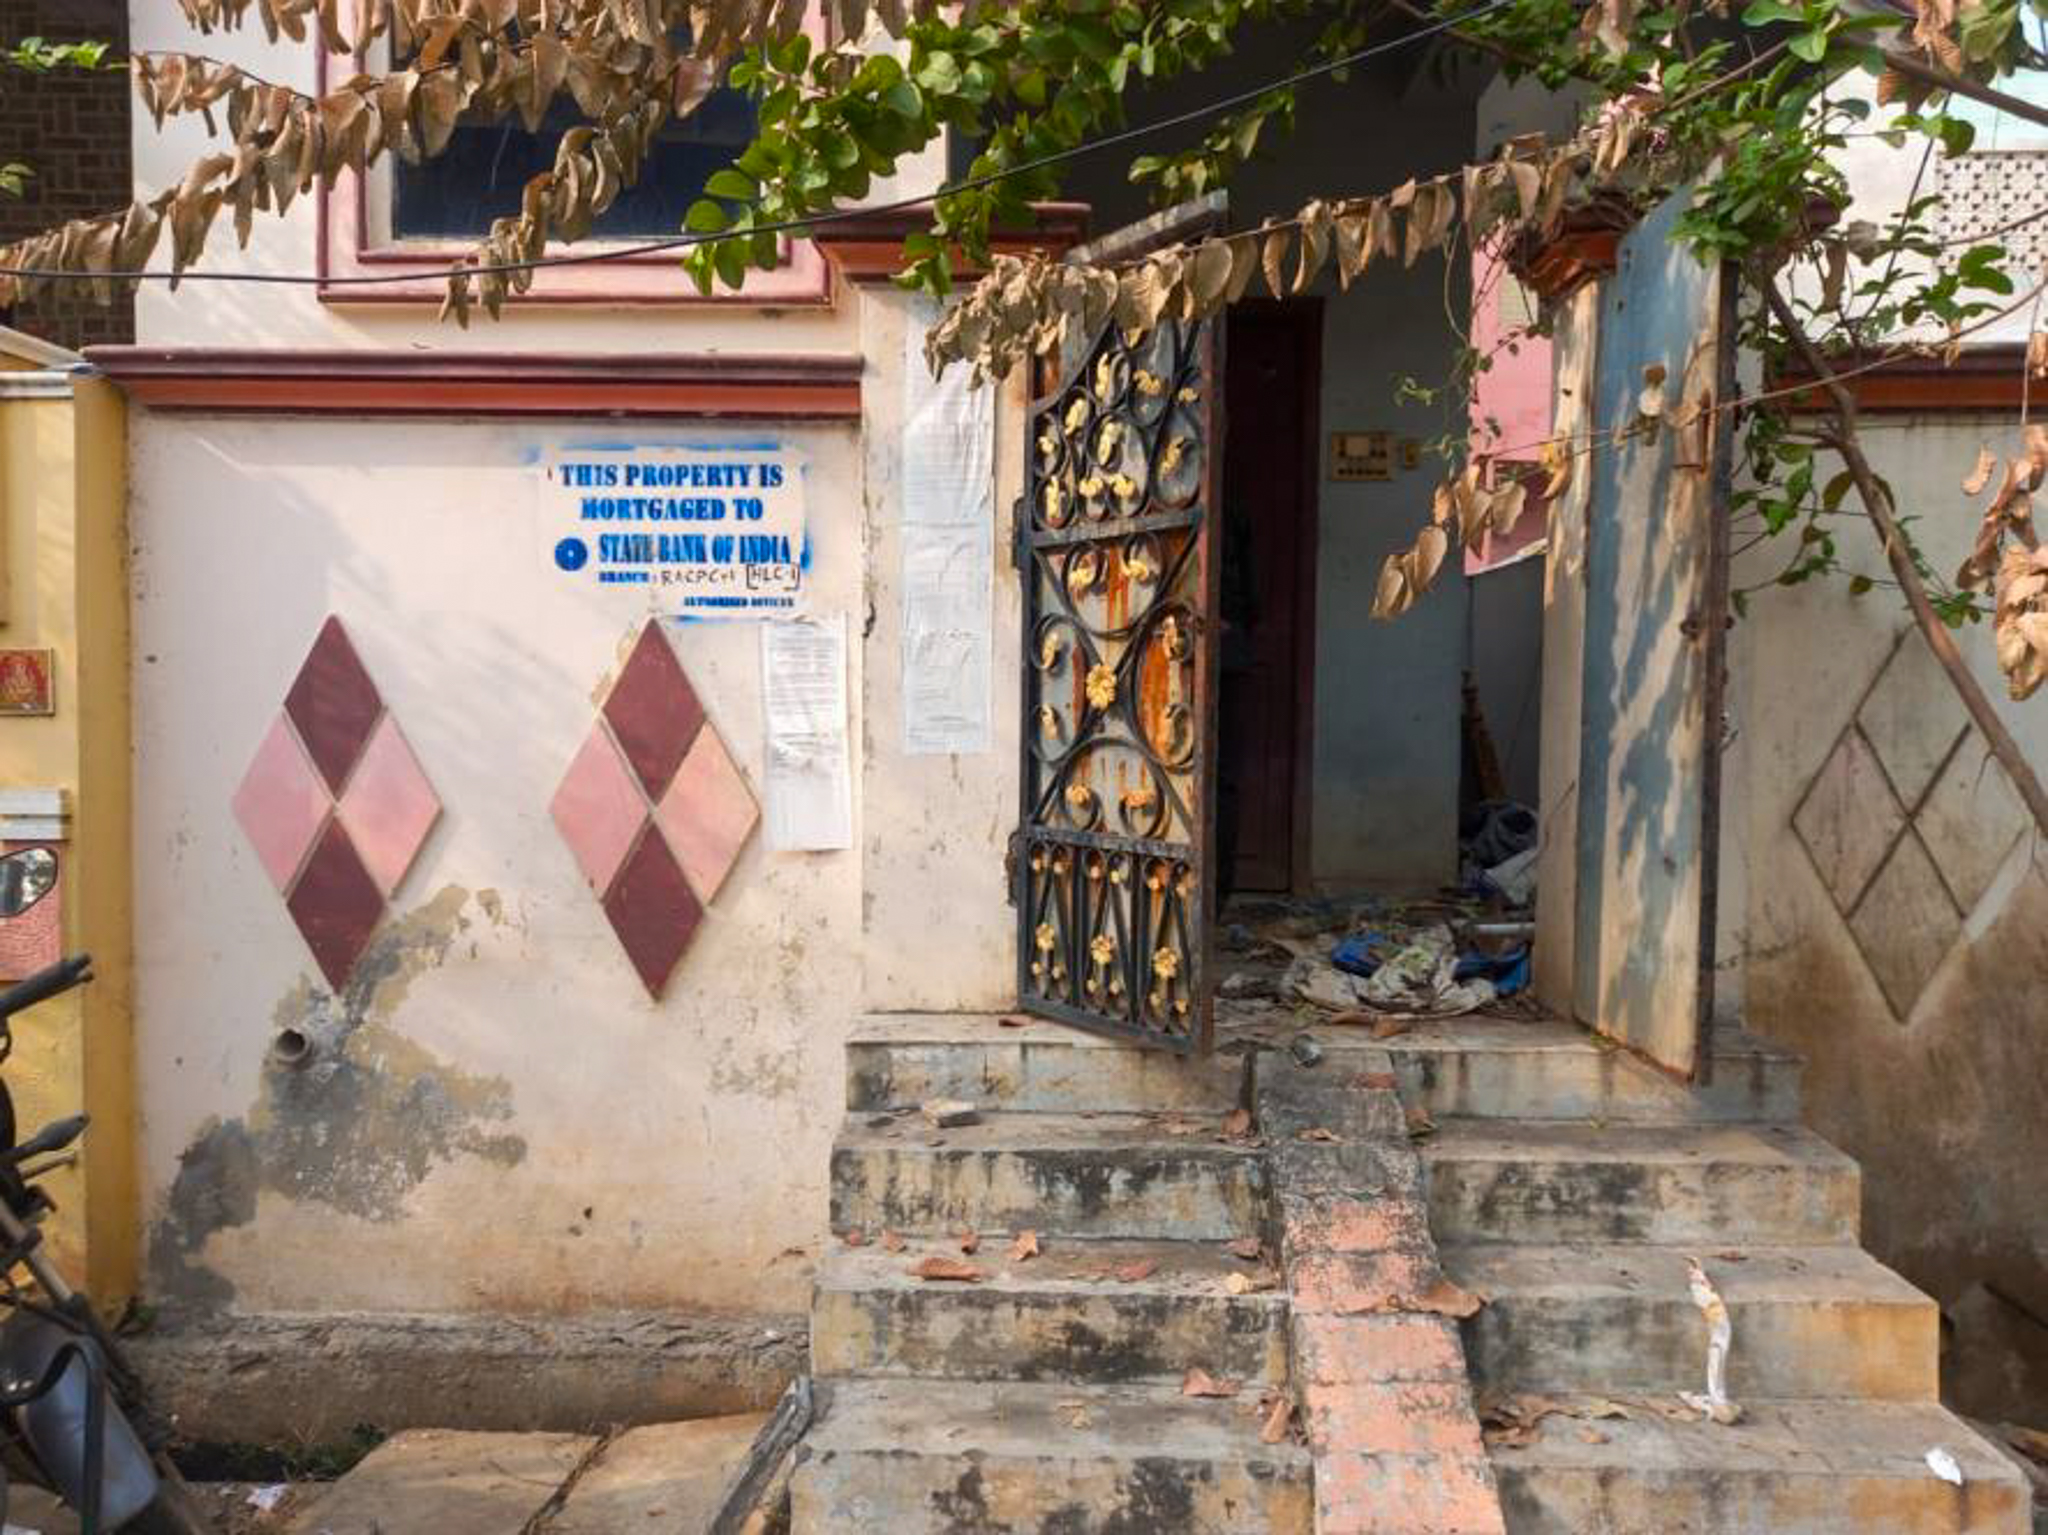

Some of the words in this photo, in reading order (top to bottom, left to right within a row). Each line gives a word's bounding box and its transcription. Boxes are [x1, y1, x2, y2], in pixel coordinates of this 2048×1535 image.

[560, 464, 618, 486] THIS
[625, 464, 751, 486] PROPERTY
[759, 464, 784, 486] IS
[580, 497, 727, 520] MORTGAGED
[732, 498, 764, 520] TO
[599, 533, 653, 563] STATE
[658, 533, 707, 563] BANK
[711, 535, 735, 564] OF
[739, 535, 791, 564] INDIA
